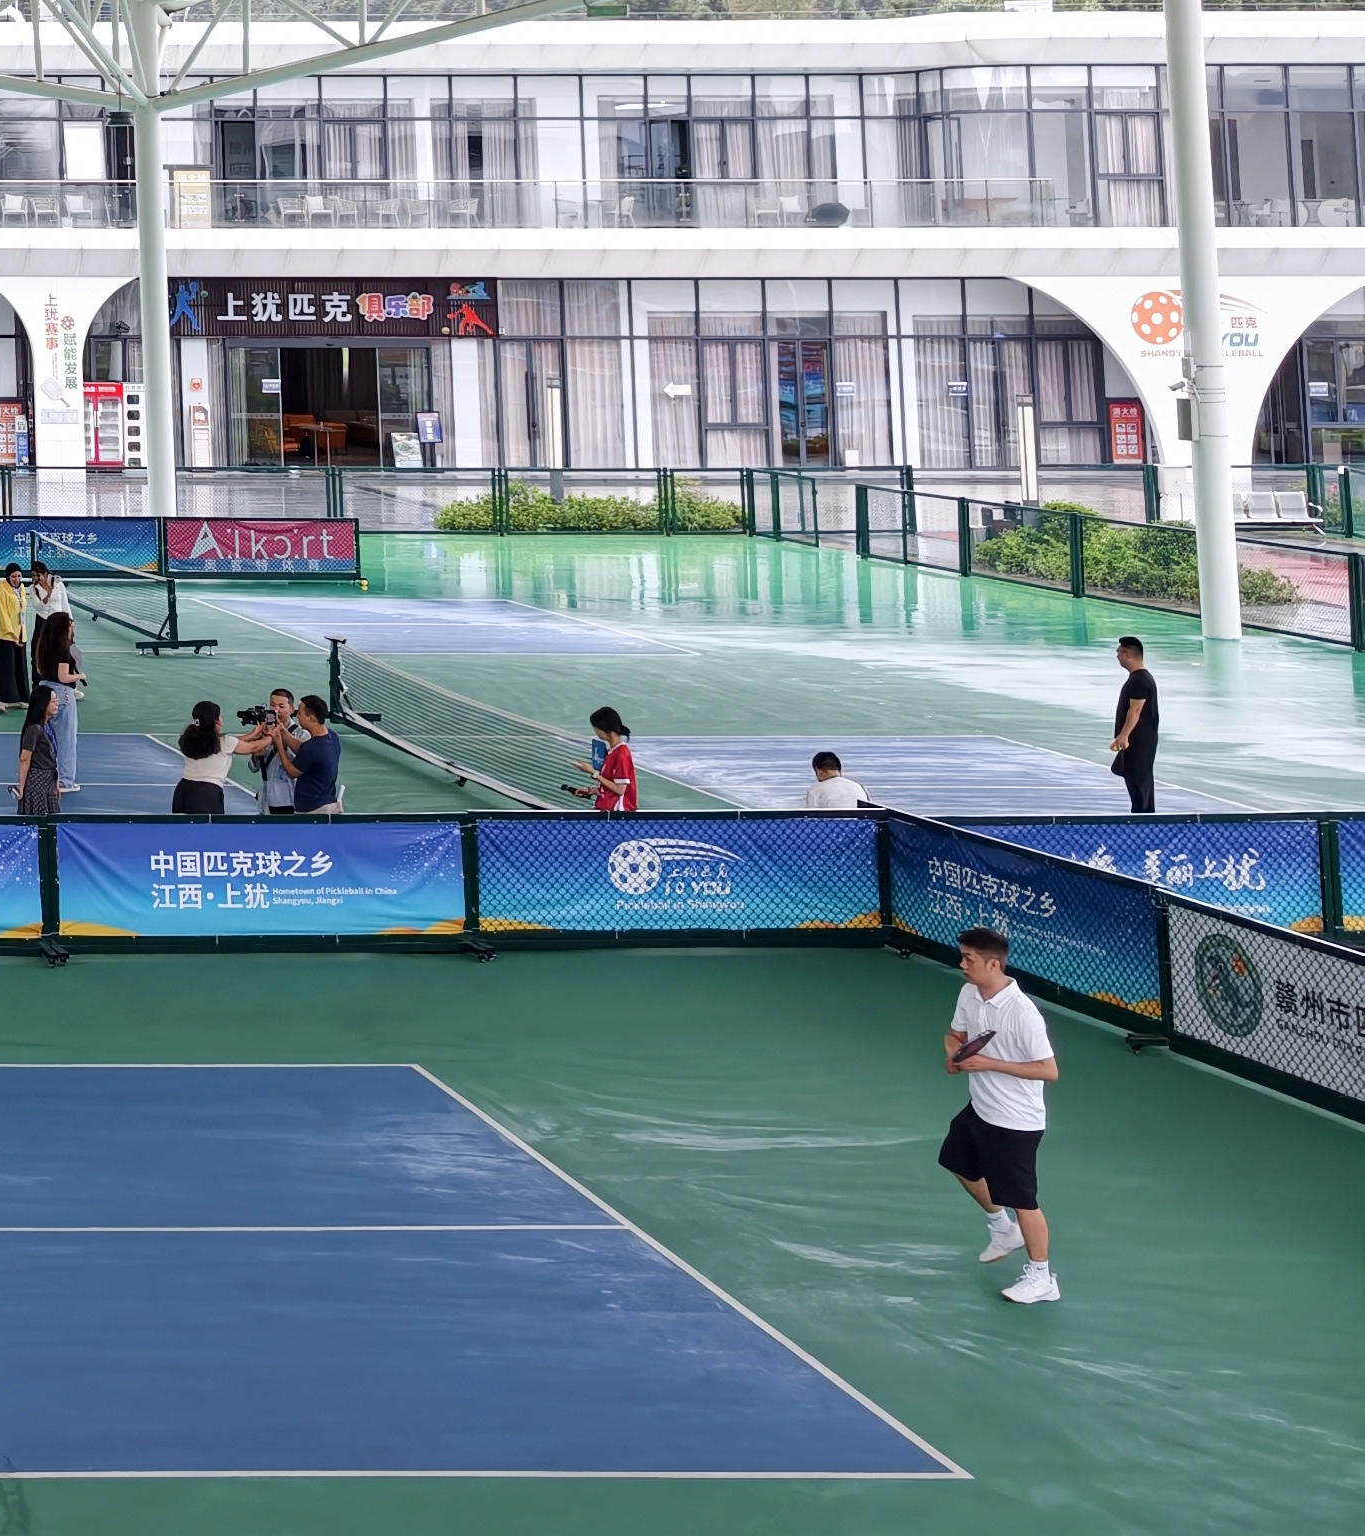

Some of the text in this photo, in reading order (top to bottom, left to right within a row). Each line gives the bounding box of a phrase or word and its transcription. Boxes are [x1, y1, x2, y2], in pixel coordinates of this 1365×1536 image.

[44, 293, 58, 350] 上犹赛事
[217, 291, 434, 323] 上犹匹克俱乐部
[63, 332, 78, 390] 赋能发展
[150, 850, 334, 878] 中国匹克球之乡
[272, 886, 397, 895] Hometown of Pickleball in China
[315, 896, 343, 906] Jiangxi
[690, 880, 731, 895] YOU
[926, 856, 1057, 918] 中国匹克球之乡
